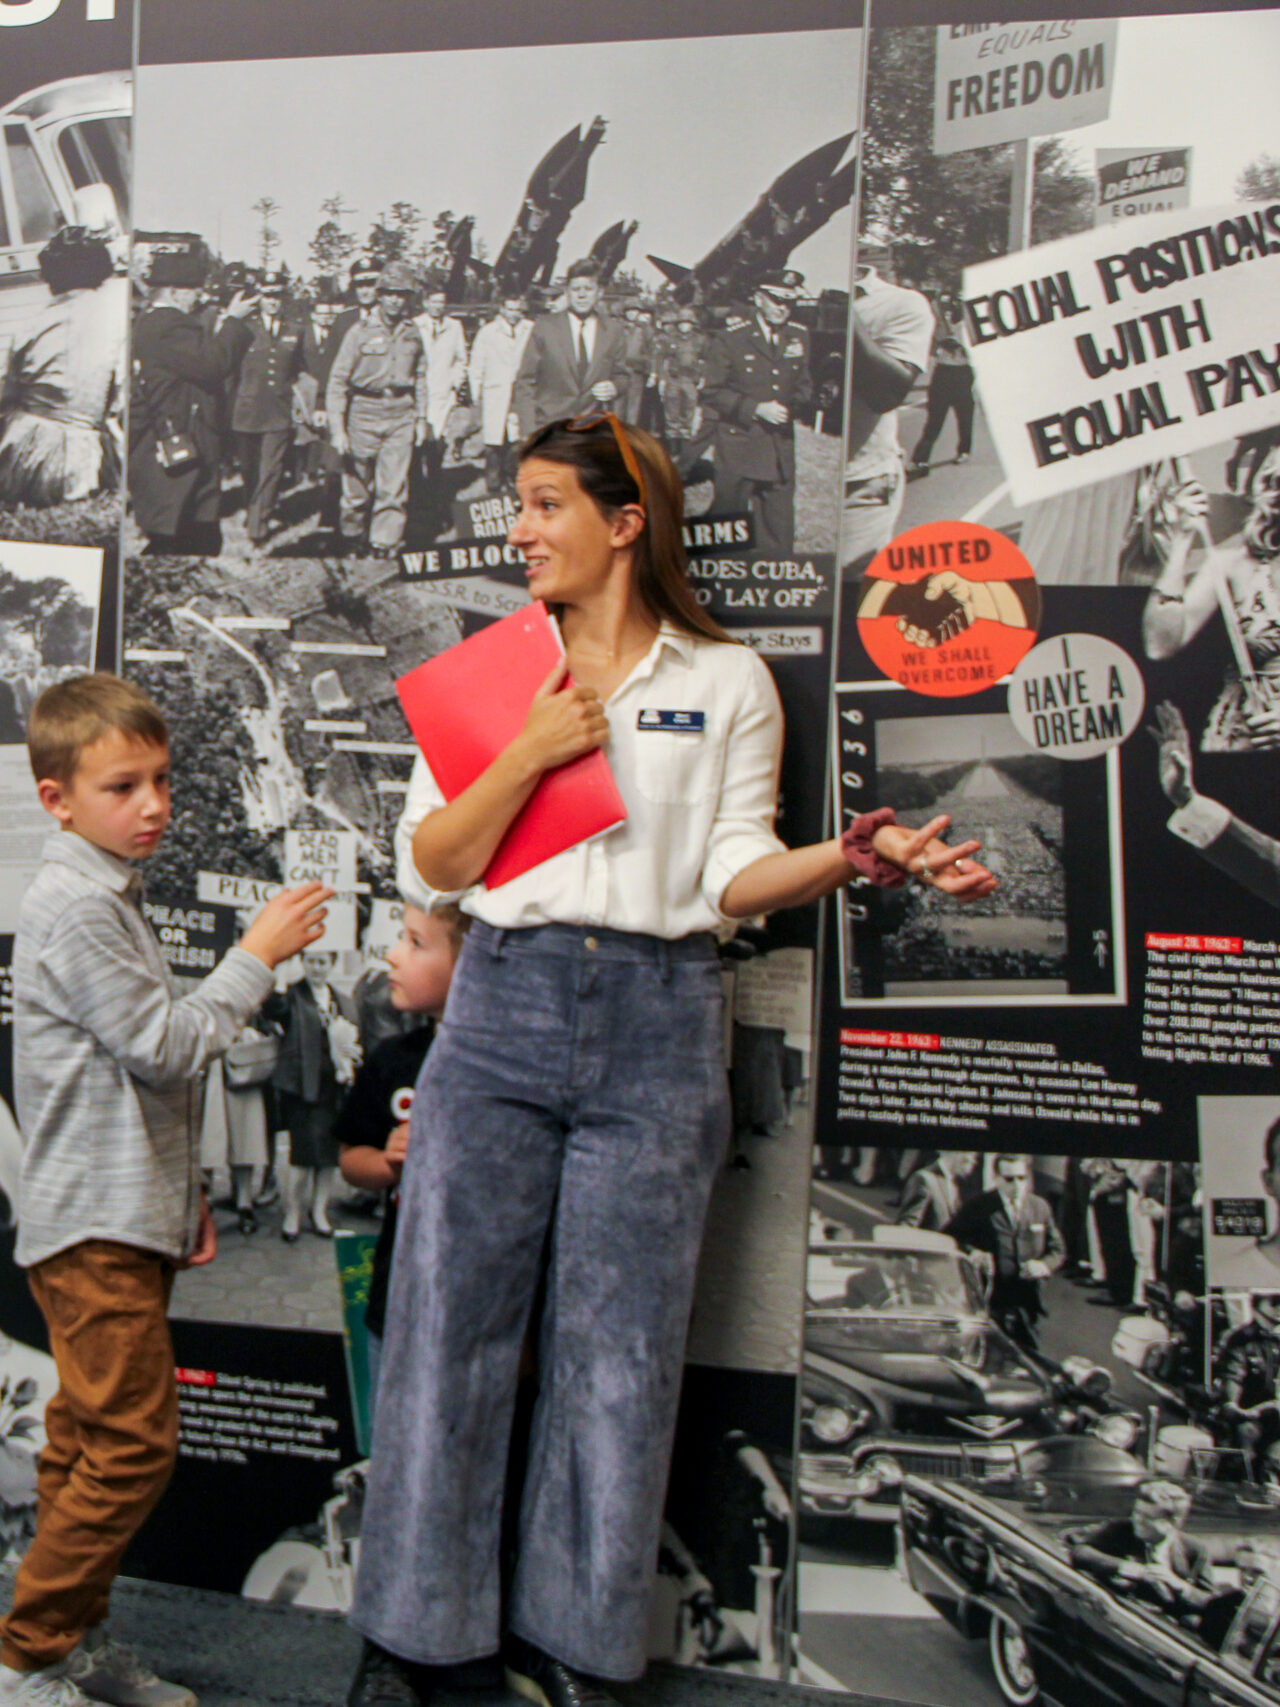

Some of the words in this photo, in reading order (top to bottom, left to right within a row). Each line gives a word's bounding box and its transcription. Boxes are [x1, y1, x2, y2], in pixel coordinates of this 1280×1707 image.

[947, 42, 1104, 121] FREEDOM
[1126, 154, 1161, 176] WE
[1104, 166, 1185, 200] DEMAND
[965, 271, 1090, 346] EQUAL
[1096, 204, 1280, 305] POSITIONS
[1076, 298, 1211, 380] WITH
[1026, 379, 1180, 467] EQUAL
[1187, 343, 1280, 416] PAY
[402, 550, 440, 574] WE
[887, 538, 993, 571] UNITED
[751, 560, 824, 584] CUBA,
[767, 632, 811, 650] Stays
[1061, 636, 1071, 671] I
[901, 650, 931, 667] WE
[937, 646, 993, 665] SHALL
[898, 664, 997, 685] OVERCOME
[1024, 669, 1088, 713] HAVE
[1108, 665, 1126, 699] A
[1033, 702, 1124, 748] DREAM
[298, 833, 339, 848] DEAD
[300, 850, 339, 865] MEN
[143, 903, 216, 932] PEACE
[159, 927, 188, 944] OR
